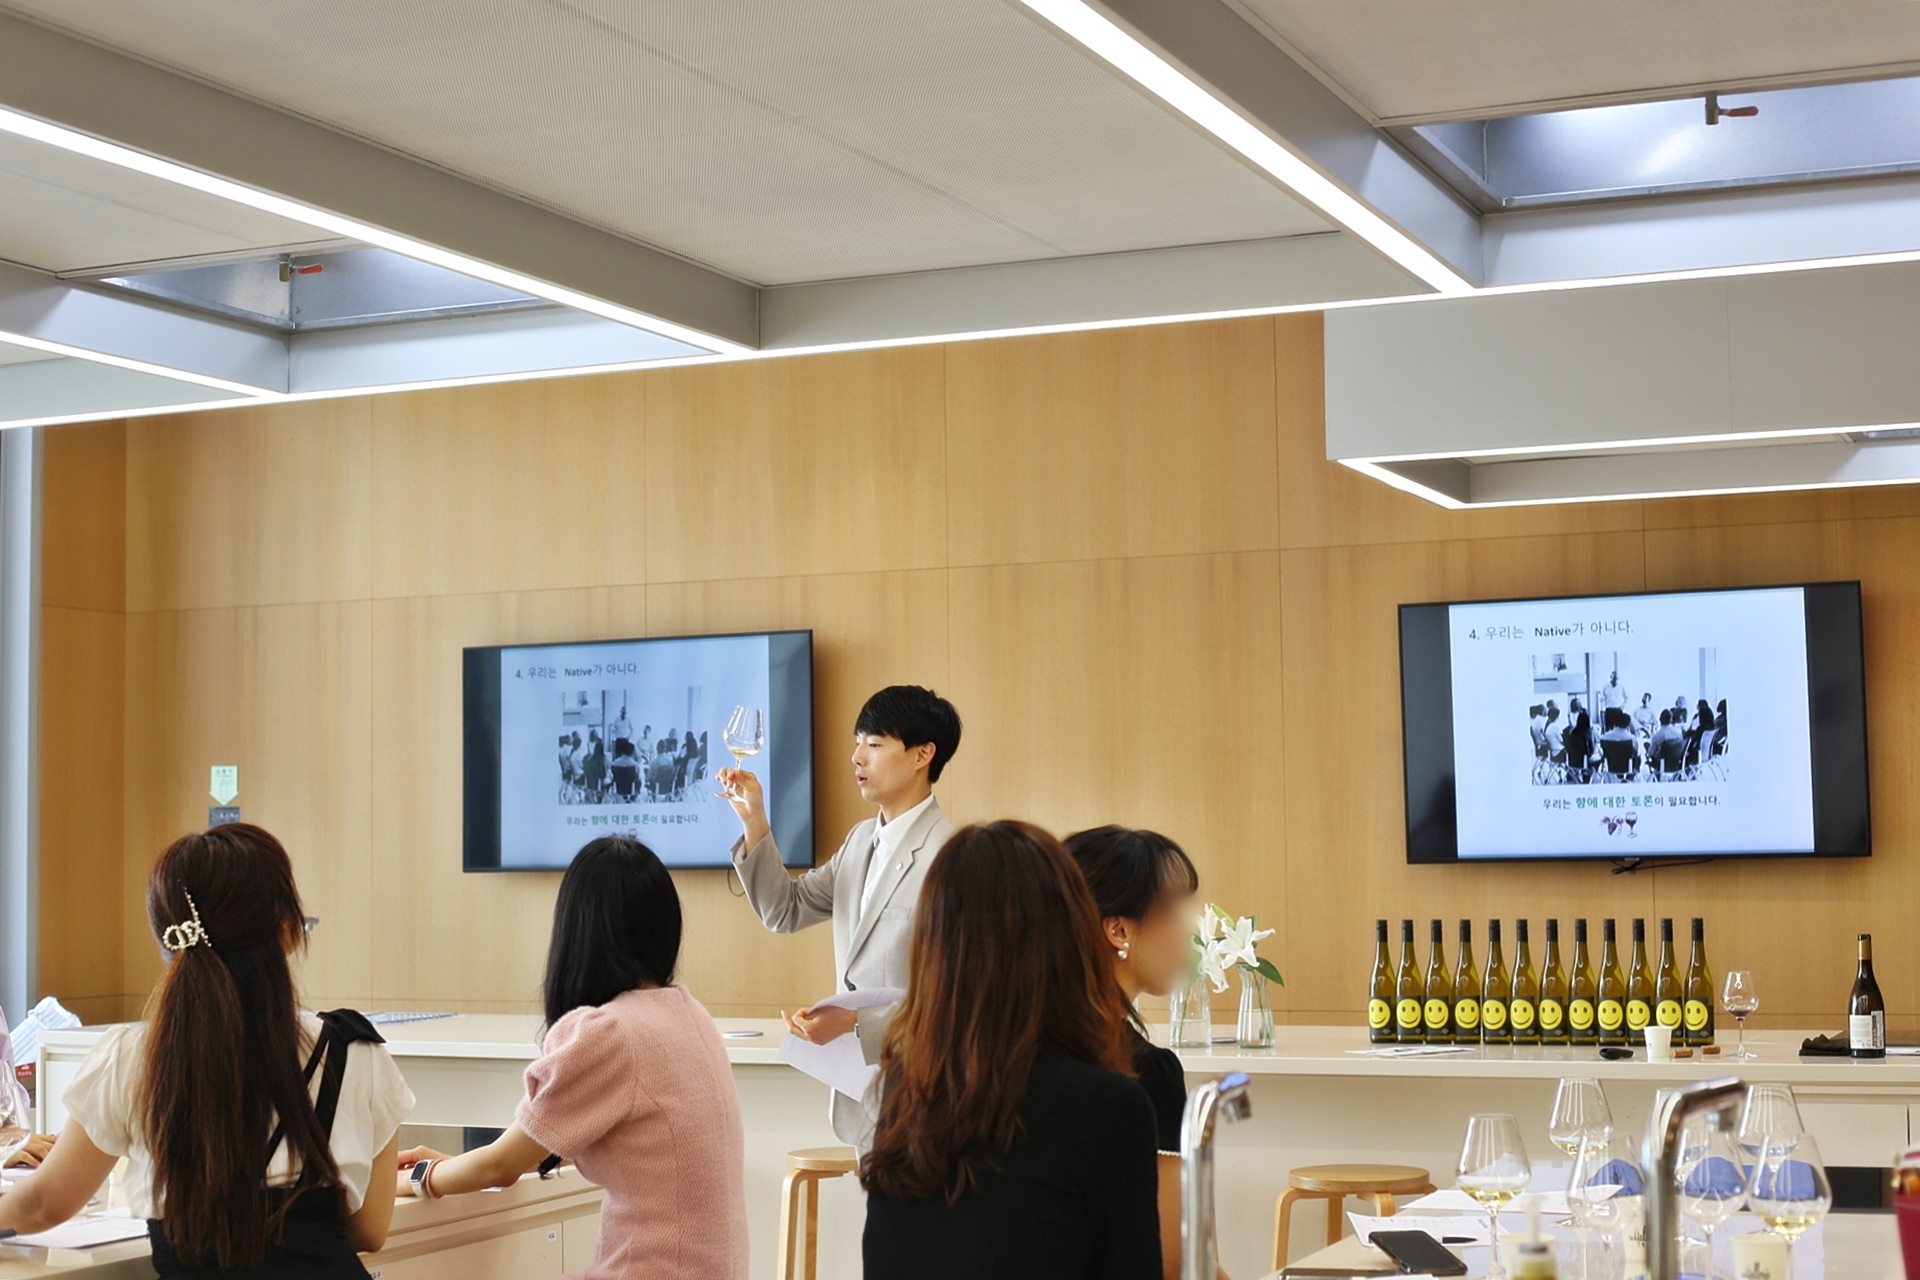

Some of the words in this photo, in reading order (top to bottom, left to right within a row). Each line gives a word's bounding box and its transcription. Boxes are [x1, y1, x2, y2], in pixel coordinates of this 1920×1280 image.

[1469, 629, 1480, 640] 4.
[1485, 625, 1525, 640] 우리는
[1534, 621, 1584, 638] Native가
[1590, 619, 1634, 636] 아니다.
[515, 669, 524, 679] 4.
[527, 666, 557, 680] 우리는
[564, 664, 602, 677] Native가
[606, 662, 640, 676] 아니다.
[1543, 798, 1571, 810] 우리는
[1576, 796, 1599, 809] 향에
[1603, 796, 1626, 808] 대한
[1631, 795, 1664, 808] 토론이
[1668, 795, 1721, 808] 필요합니다.
[566, 816, 588, 827] 우리는
[611, 814, 630, 826] 대한
